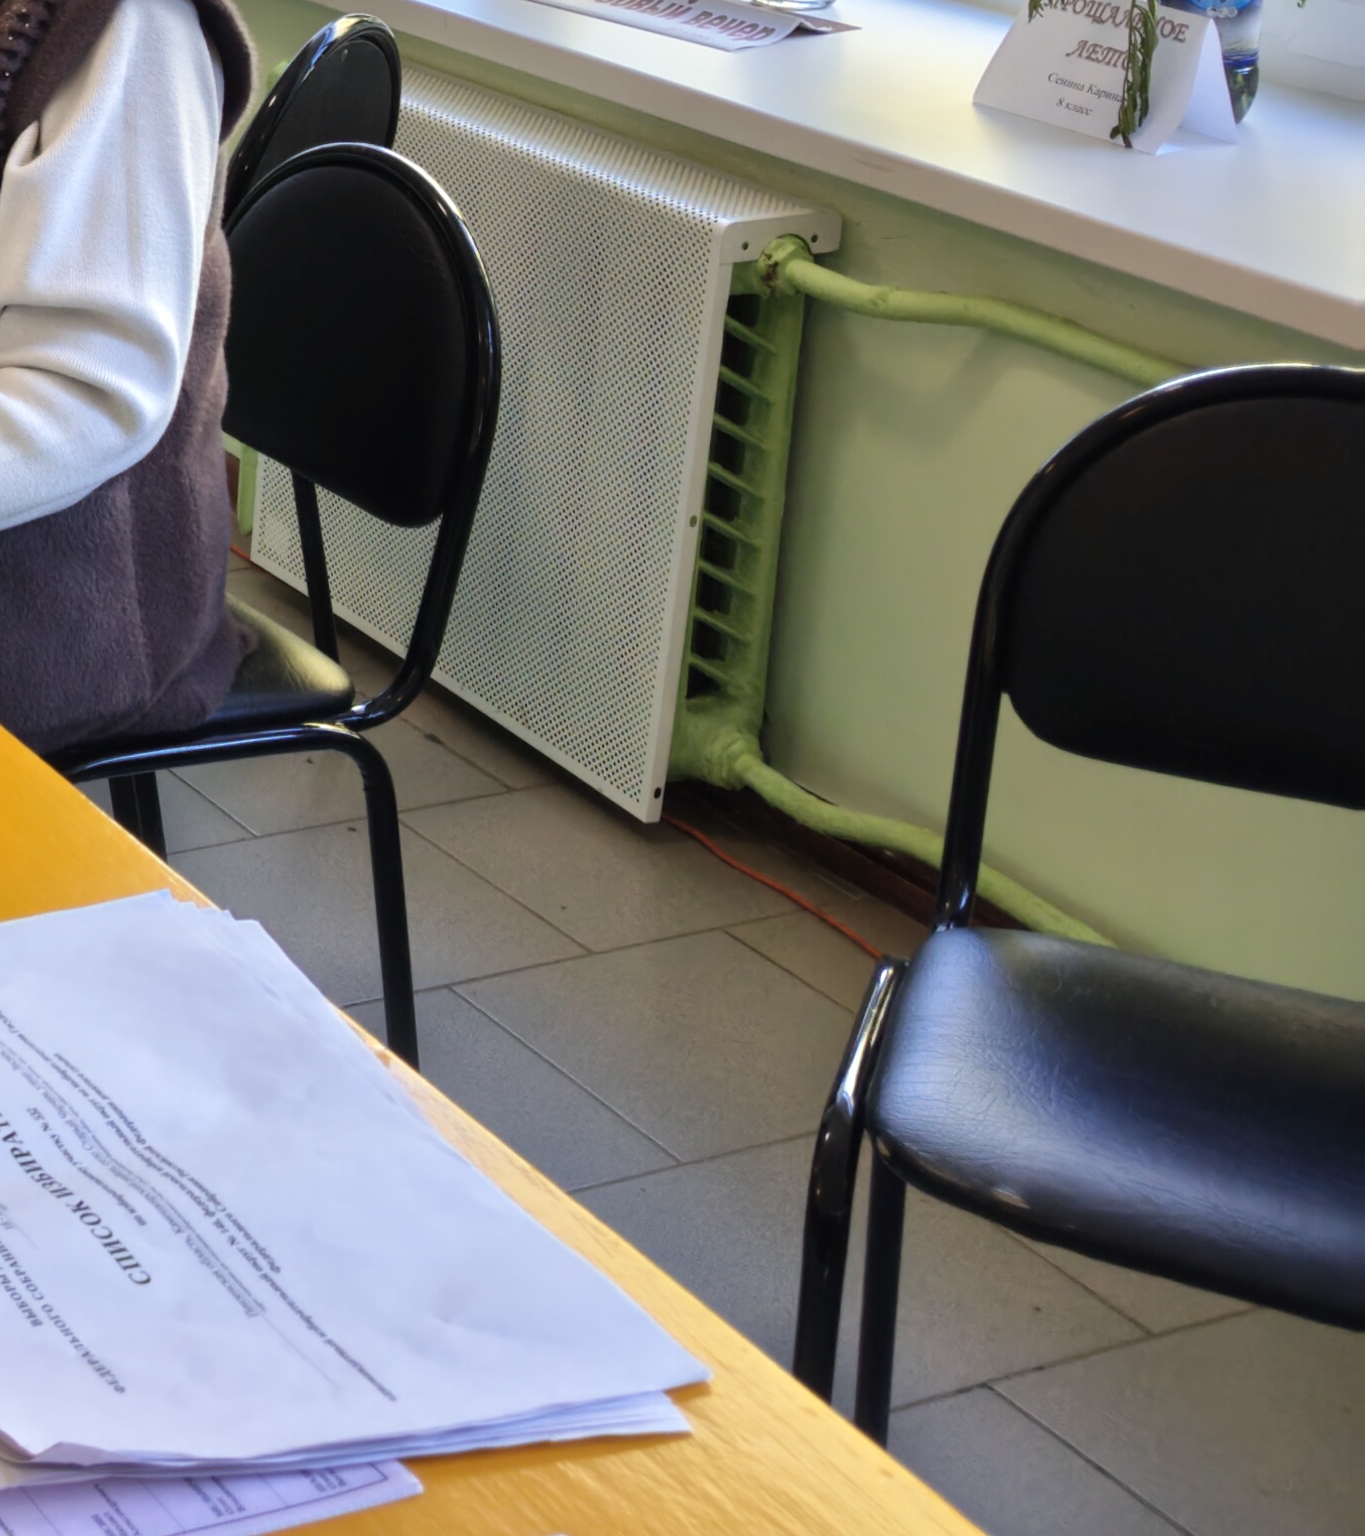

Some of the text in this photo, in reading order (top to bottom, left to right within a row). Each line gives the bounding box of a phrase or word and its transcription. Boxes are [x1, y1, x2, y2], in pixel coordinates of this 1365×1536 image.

[50, 1133, 82, 1167] участку
[65, 1195, 154, 1289] СПИСОК
[223, 1211, 282, 1274] Федерального
[39, 1302, 127, 1395] ФЕДЕРАЛЬНОГО
